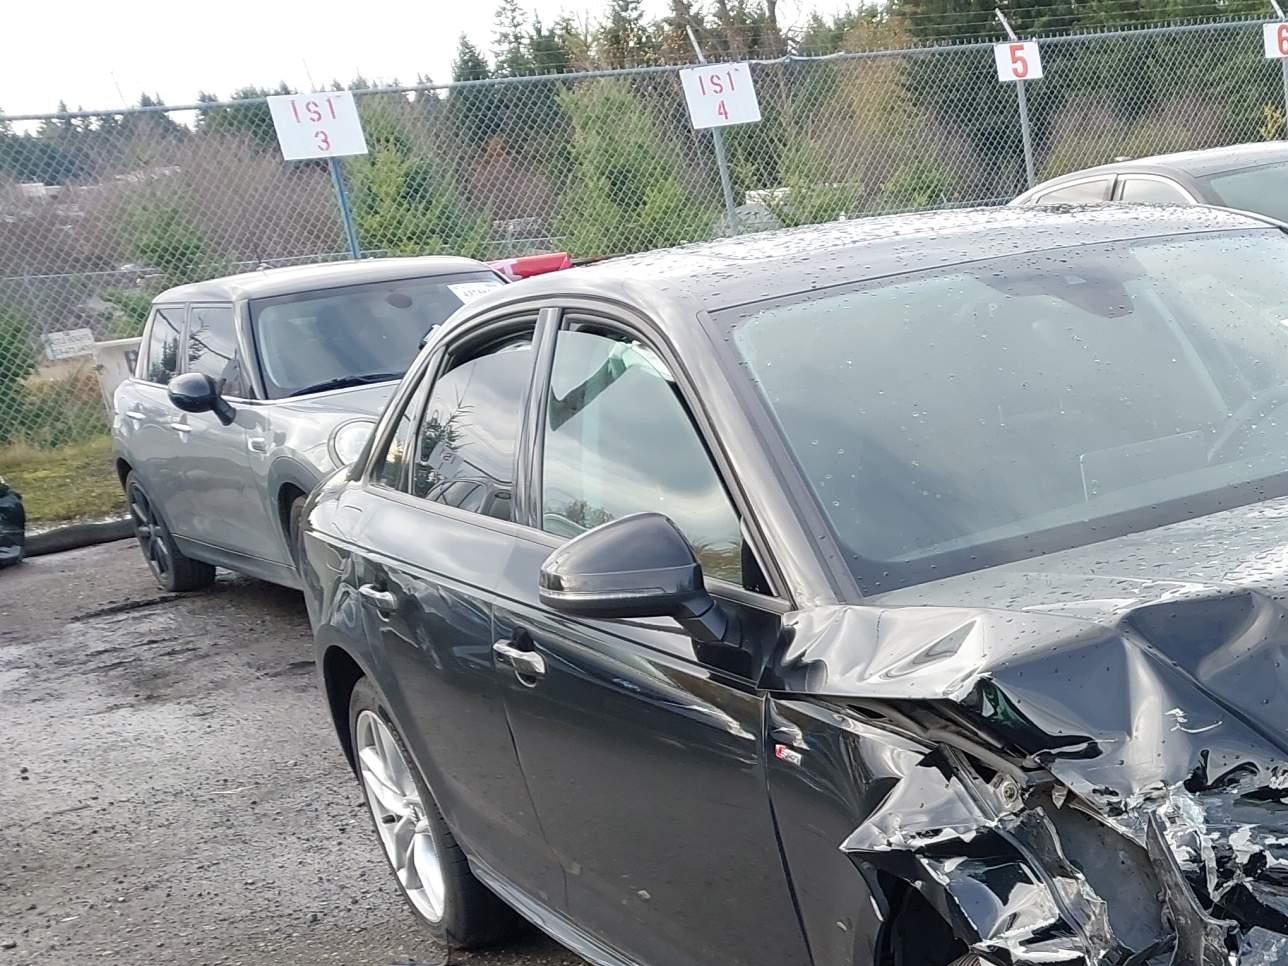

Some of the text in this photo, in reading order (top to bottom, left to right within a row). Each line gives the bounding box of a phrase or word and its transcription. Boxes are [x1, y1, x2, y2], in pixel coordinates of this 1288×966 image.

[1008, 43, 1029, 79] 5
[718, 99, 729, 120] 4
[314, 130, 330, 152] 3
